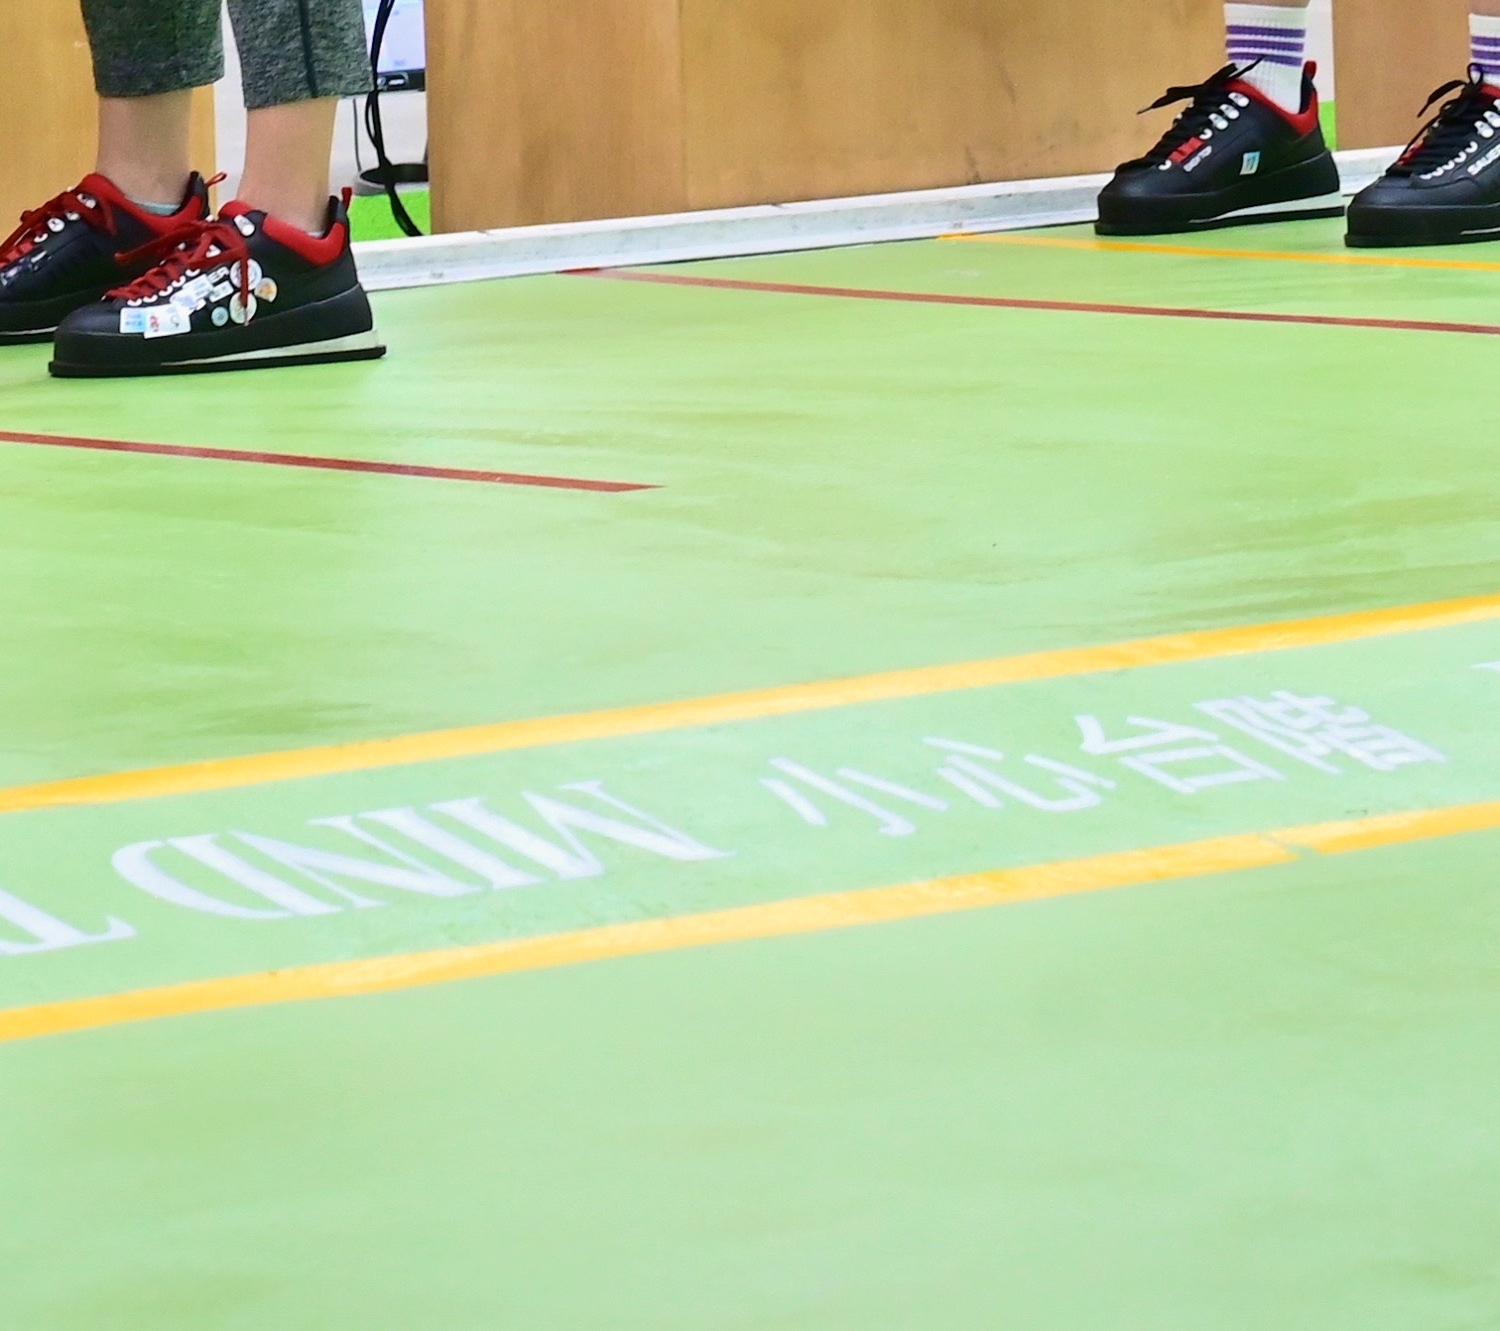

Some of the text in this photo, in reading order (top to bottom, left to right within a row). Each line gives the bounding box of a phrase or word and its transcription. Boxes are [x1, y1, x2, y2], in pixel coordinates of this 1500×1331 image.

[762, 691, 1448, 837] 小心台階
[110, 779, 732, 924] MIND
